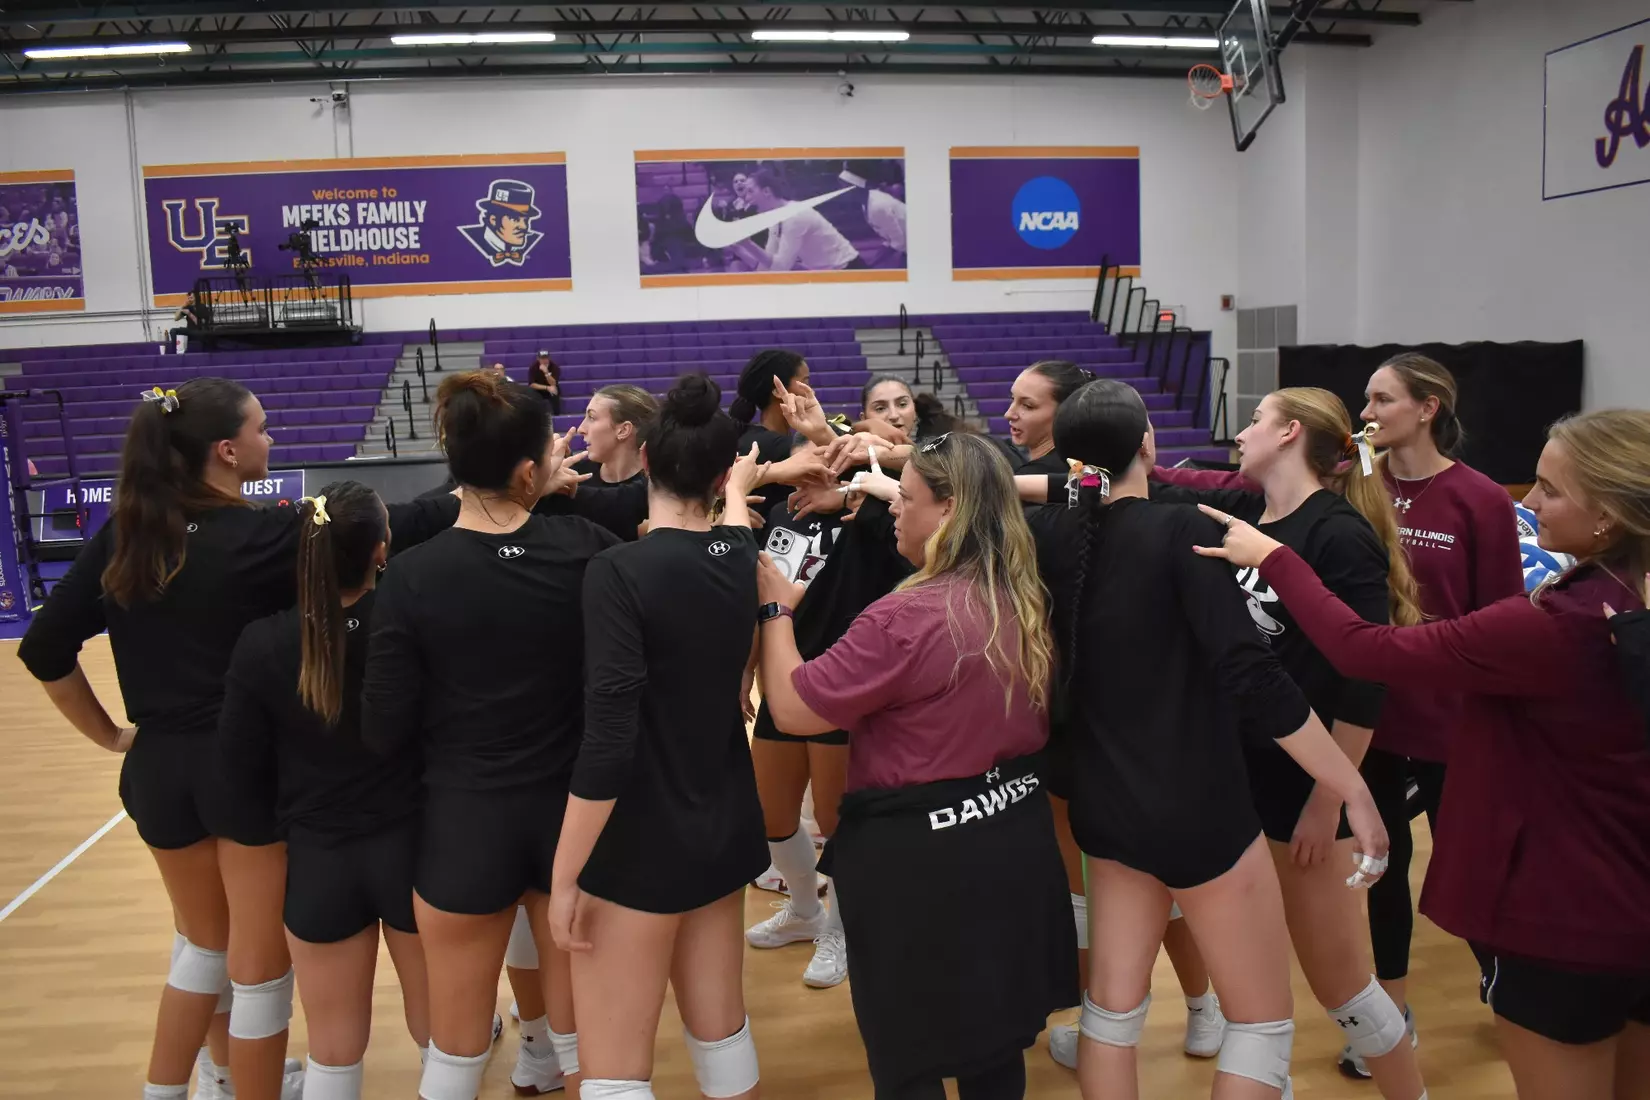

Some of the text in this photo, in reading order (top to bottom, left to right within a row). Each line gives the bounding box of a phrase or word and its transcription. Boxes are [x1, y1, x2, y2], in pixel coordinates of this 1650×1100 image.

[312, 186, 397, 200] Welcome to
[356, 200, 427, 225] FAMILY
[1019, 211, 1080, 231] NCAA
[299, 226, 421, 253] IELDHOUSE
[293, 252, 430, 268] Esville, Indiana
[240, 478, 284, 496] UEST
[1414, 529, 1455, 544] ILLINOIS
[928, 772, 1040, 831] DAWGS
